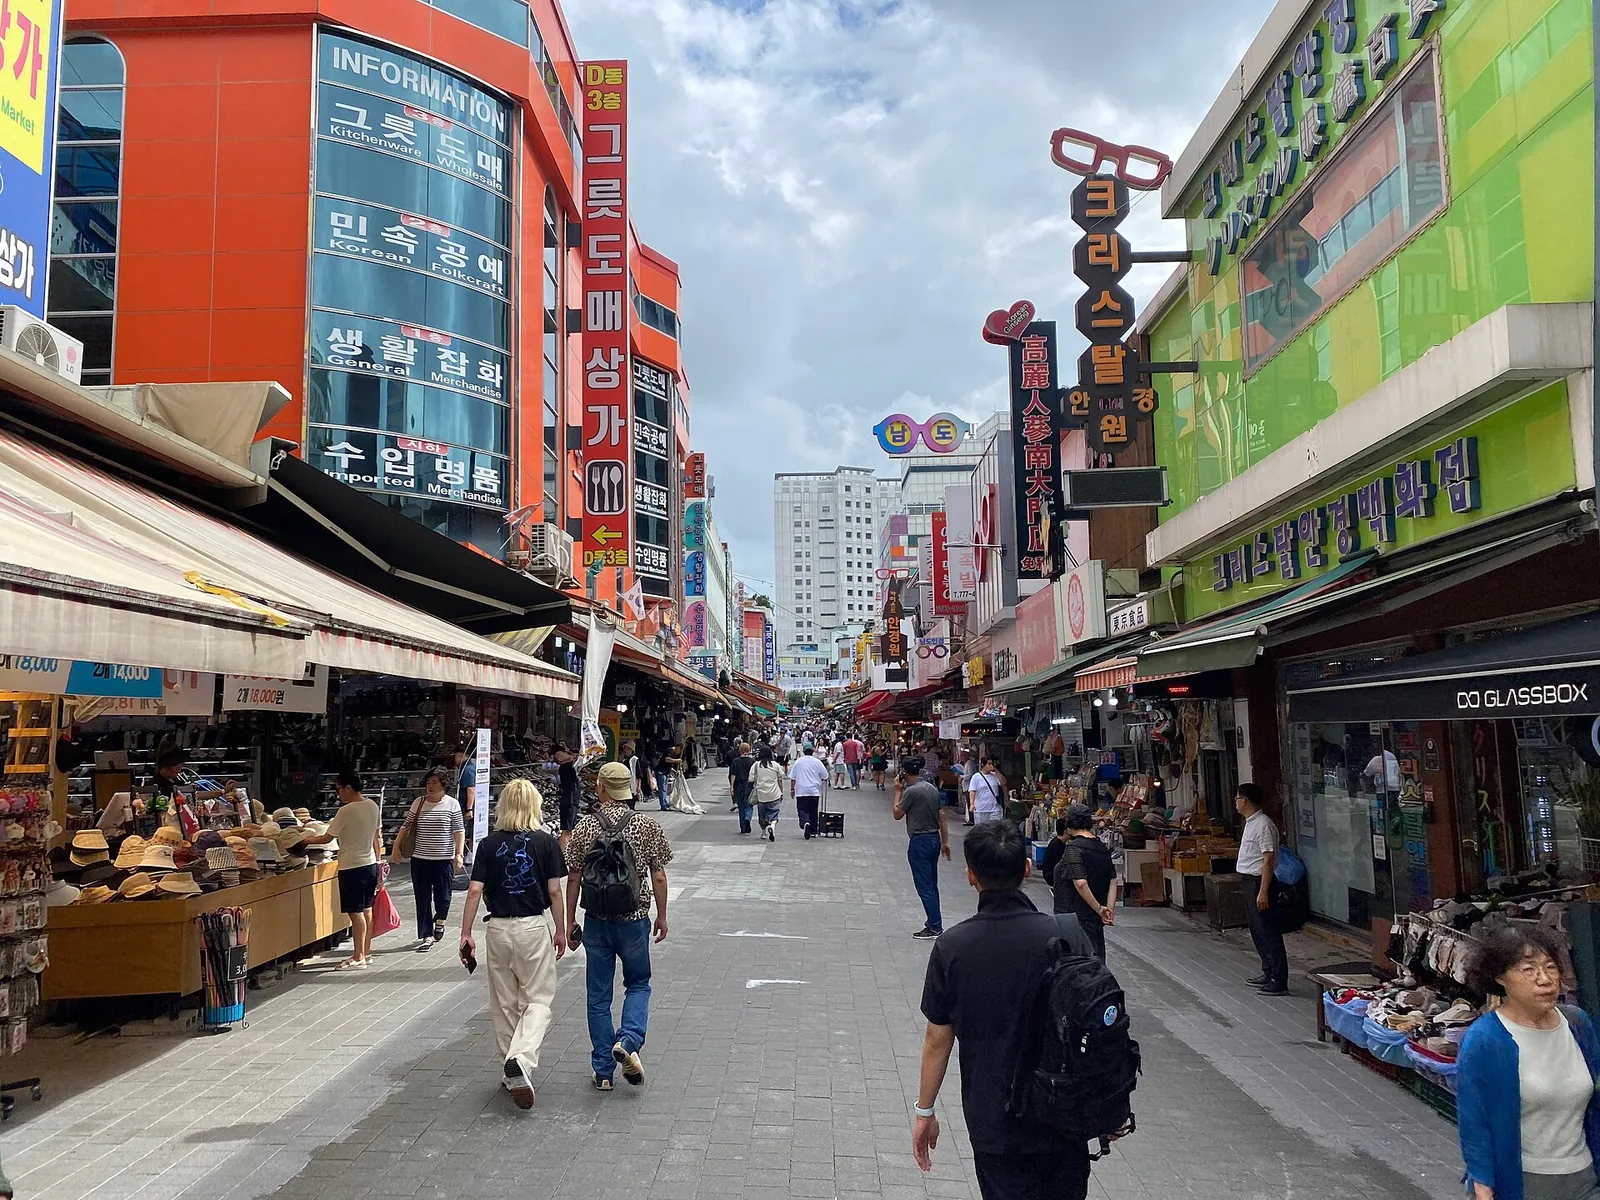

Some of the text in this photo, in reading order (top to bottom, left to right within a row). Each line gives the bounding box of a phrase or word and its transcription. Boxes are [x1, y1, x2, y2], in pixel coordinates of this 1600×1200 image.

[333, 47, 505, 132] INFORMATION
[586, 65, 623, 86] D동
[1, 96, 35, 136] Market
[586, 90, 622, 111] 3층
[330, 103, 503, 182] 그릇 도매
[330, 125, 503, 190] Kitchenware Wholesale
[330, 211, 503, 285] 민속 공예
[330, 239, 504, 295] Korean Folkcraft
[586, 124, 625, 447] 그릇도매상가
[1086, 181, 1126, 385] 크리스탈
[1003, 310, 1030, 334] Ginseng
[1005, 303, 1029, 324] Korean
[66, 364, 74, 374] LG
[327, 327, 504, 388] 생활 잡화
[327, 354, 502, 399] General Merchandise
[406, 439, 442, 454] 지하
[323, 468, 503, 506] Imported Merchandise
[324, 441, 502, 494] 수입 명품
[694, 455, 704, 495] 그릇도매
[1113, 605, 1145, 633] 東京食品
[93, 662, 110, 679] 2개
[112, 664, 150, 682] 14,000
[237, 688, 250, 703] 2개
[1484, 683, 1588, 708] GLASSBOX
